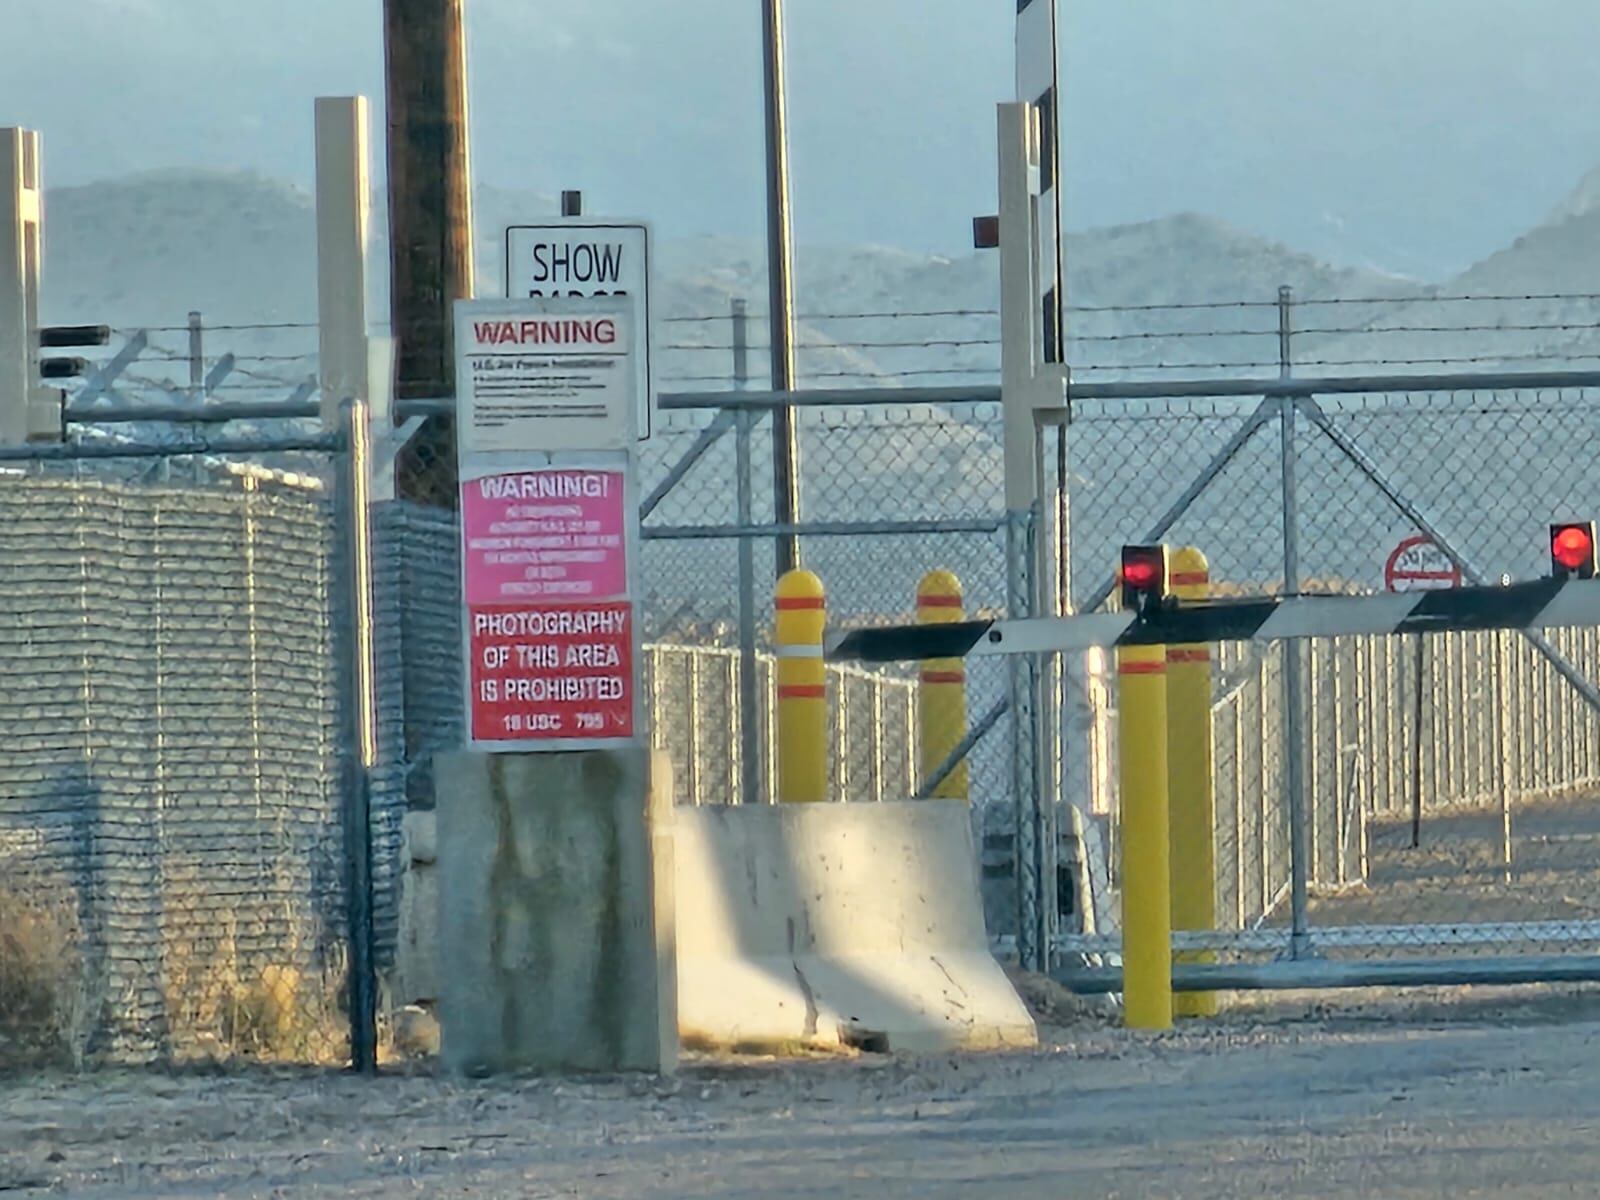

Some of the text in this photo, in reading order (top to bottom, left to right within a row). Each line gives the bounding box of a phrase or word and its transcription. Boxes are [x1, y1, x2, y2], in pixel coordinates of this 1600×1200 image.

[533, 243, 622, 282] SHOW
[474, 320, 615, 344] WARNING
[480, 474, 608, 499] WARNING!
[475, 611, 625, 636] PHOTOGRAPHY
[484, 644, 620, 669] OF THIS AREA
[481, 676, 623, 701] IS PROHIBITED
[526, 714, 562, 730] USC
